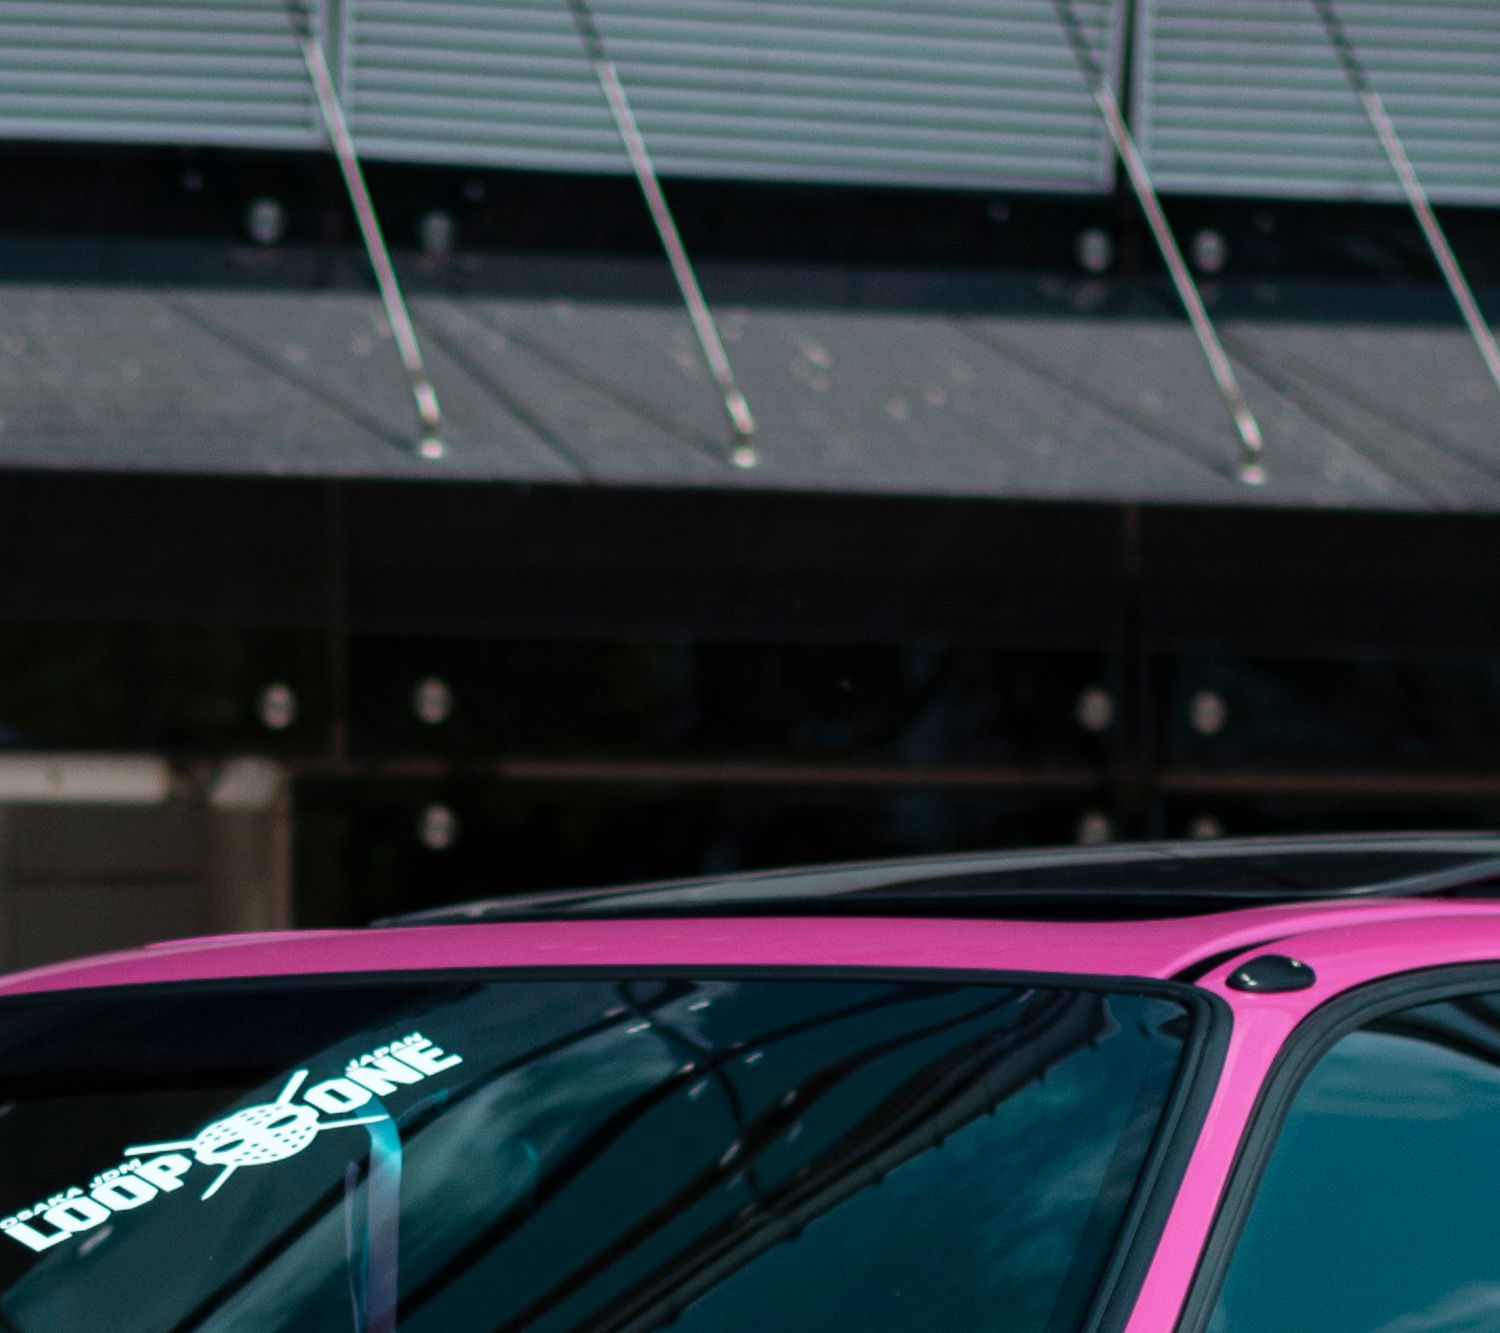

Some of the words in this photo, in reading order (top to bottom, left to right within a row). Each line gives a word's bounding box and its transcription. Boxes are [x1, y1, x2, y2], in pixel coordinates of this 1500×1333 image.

[345, 1031, 424, 1074] JAPAN
[4, 1153, 192, 1252] LOOP
[303, 1038, 463, 1114] ONE
